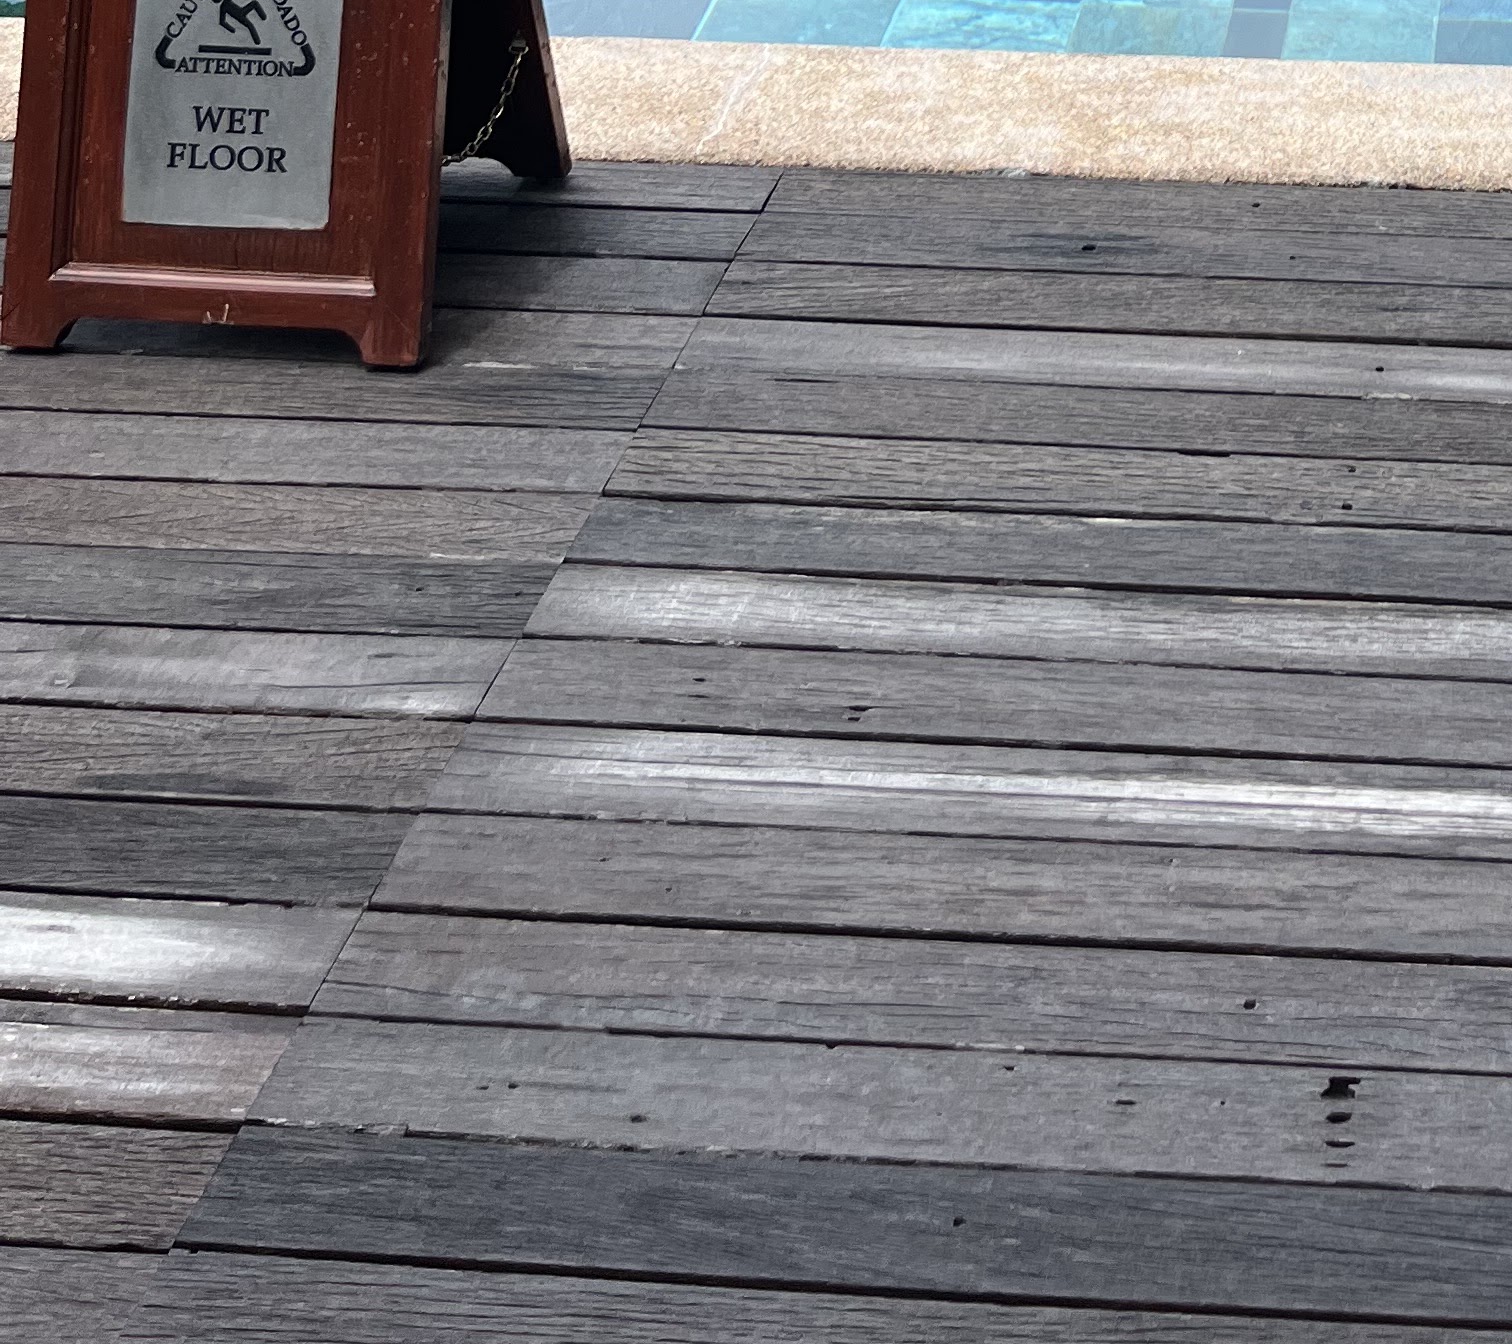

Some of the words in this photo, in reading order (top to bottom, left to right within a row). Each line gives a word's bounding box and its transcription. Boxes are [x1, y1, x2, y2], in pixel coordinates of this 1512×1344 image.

[174, 56, 296, 77] ATTENTION
[192, 105, 270, 135] WET
[166, 142, 288, 173] FLOOR
